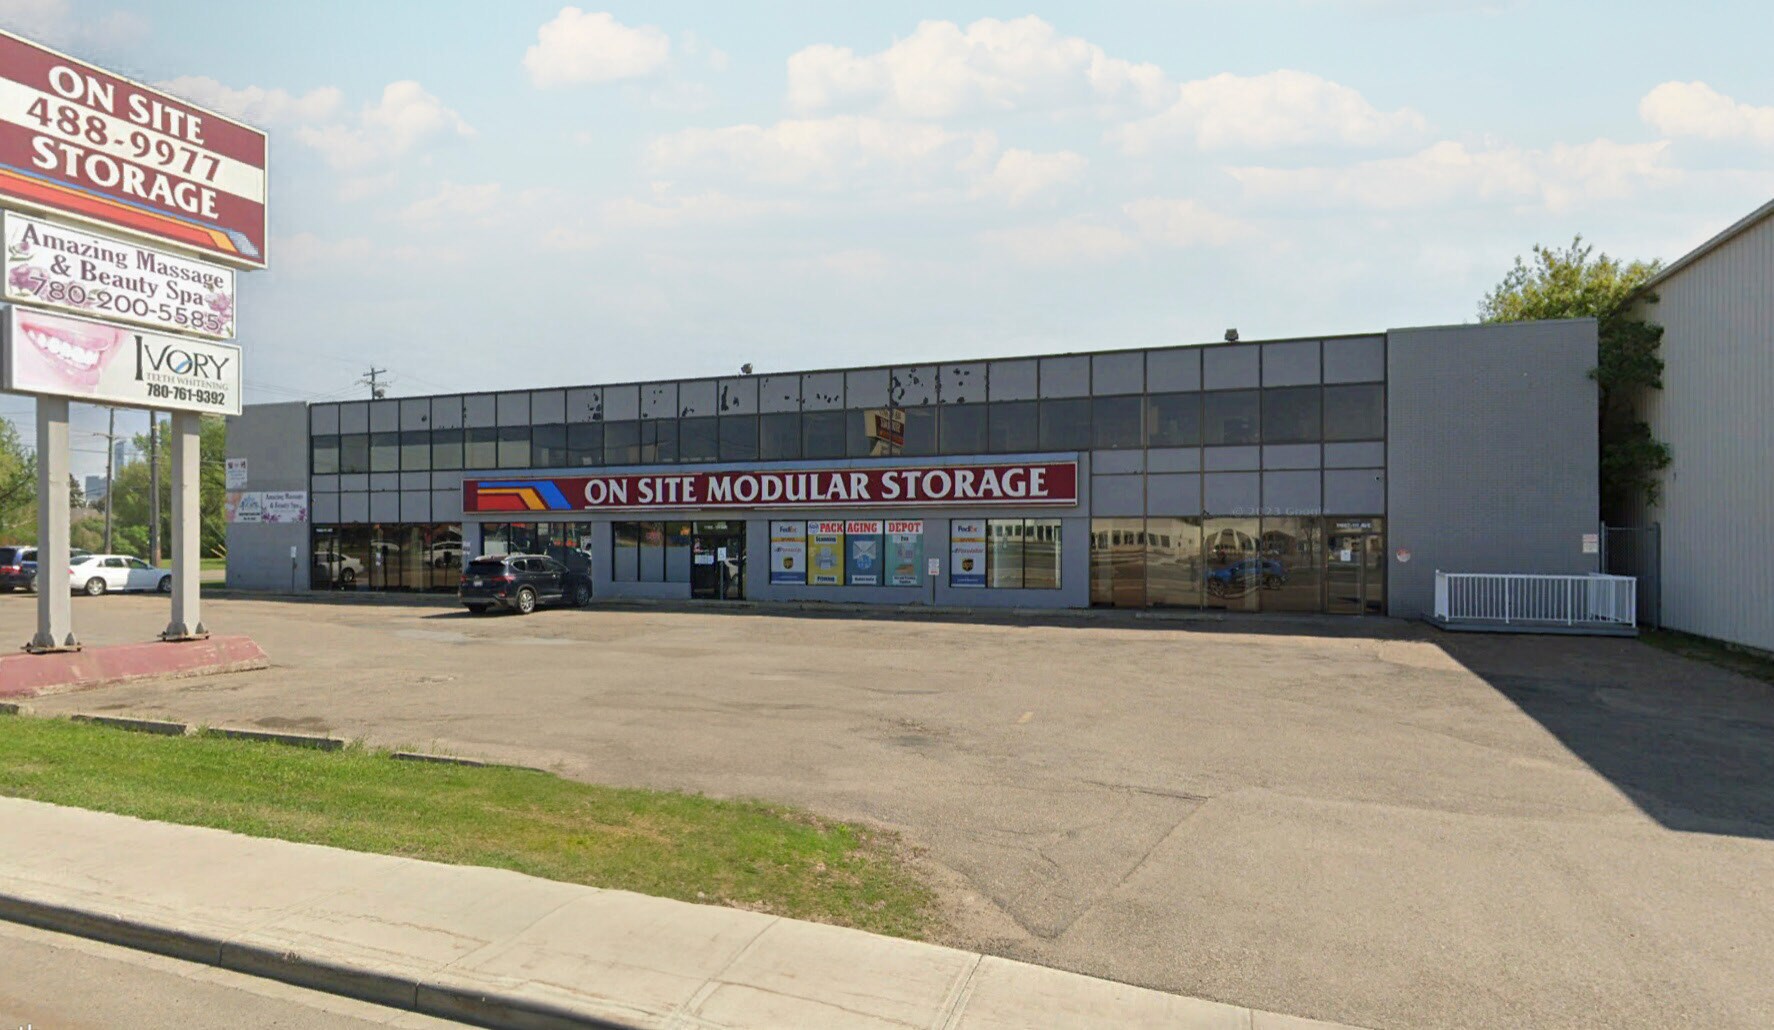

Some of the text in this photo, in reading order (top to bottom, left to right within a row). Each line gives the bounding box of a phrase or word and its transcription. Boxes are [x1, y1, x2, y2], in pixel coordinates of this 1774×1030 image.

[48, 65, 205, 145] ON SITE
[26, 97, 221, 183] 488-9977
[32, 135, 220, 219] STORAGE
[21, 223, 225, 289] Amazing Massage
[50, 254, 204, 306] & Beauty Spa
[30, 274, 220, 331] 780-200-5585
[134, 335, 230, 381] IVORY
[147, 372, 229, 391] TEETH WHITENING
[146, 382, 226, 406] 780-761-9392
[584, 467, 1049, 505] ON SITE MODULAR STORAGE
[819, 522, 844, 533] PACK
[847, 522, 878, 533] AGING
[888, 522, 921, 533] DEPOT
